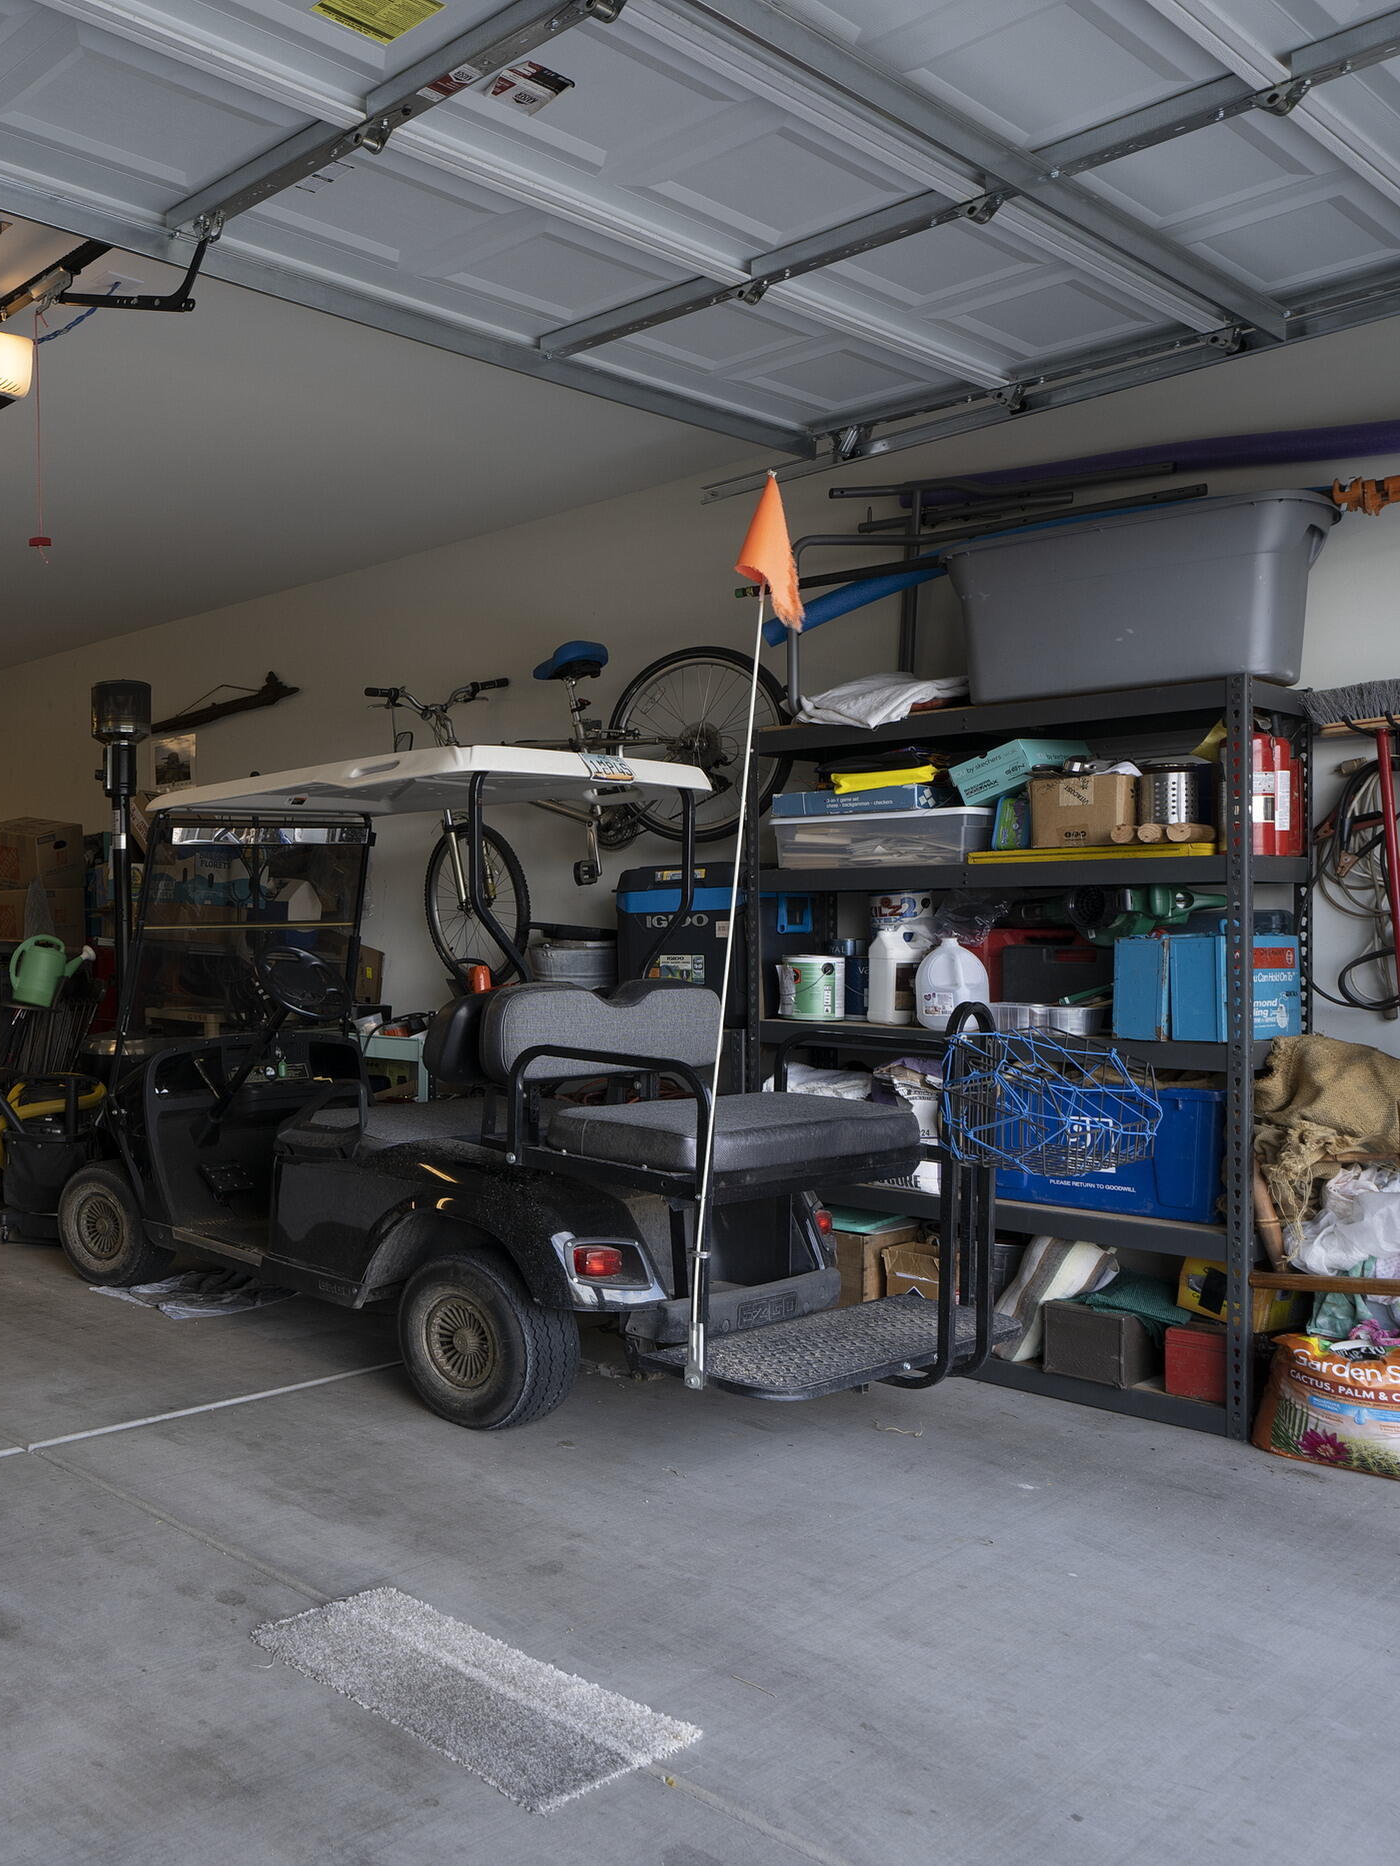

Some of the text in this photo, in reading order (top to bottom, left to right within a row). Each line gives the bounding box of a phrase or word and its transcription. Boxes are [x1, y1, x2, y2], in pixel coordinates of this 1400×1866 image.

[975, 755, 1002, 770] skechers
[1064, 784, 1089, 806] VITACOST
[646, 913, 709, 929] IGO
[858, 966, 869, 975] Va
[1258, 972, 1268, 982] Can
[1269, 972, 1279, 982] Hold
[1280, 972, 1287, 981] On
[1253, 998, 1278, 1007] mond
[1253, 1008, 1269, 1017] ling
[1071, 1180, 1096, 1189] RETURN
[1104, 1184, 1137, 1193] GOODWILL
[1292, 1348, 1383, 1383] Garden
[1289, 1369, 1335, 1393] CACTUS,
[1338, 1386, 1375, 1400] PALM
[1378, 1392, 1389, 1401] &
